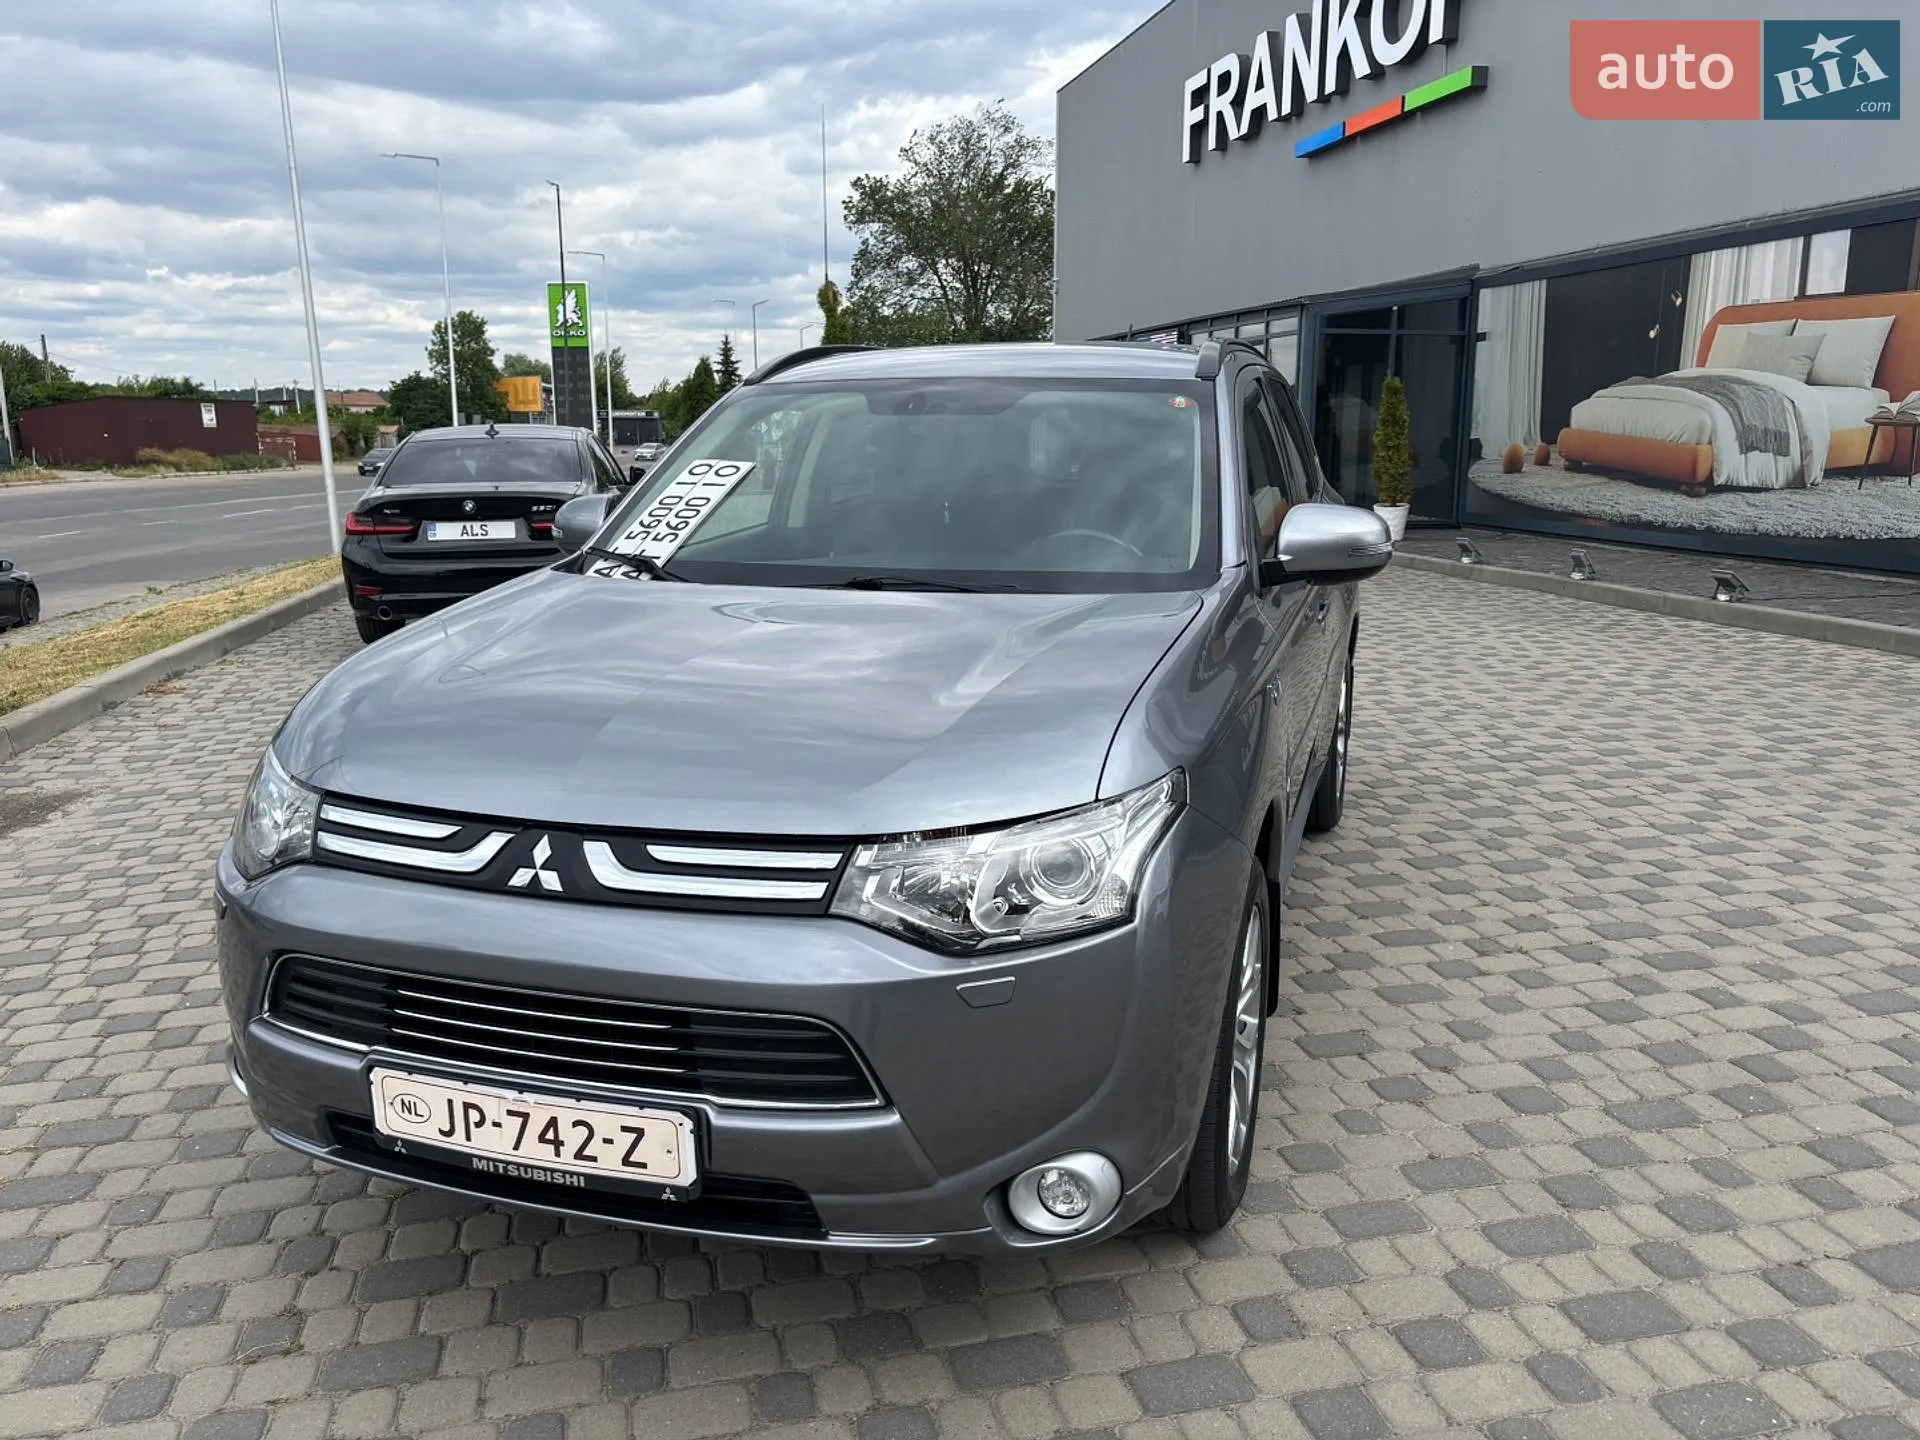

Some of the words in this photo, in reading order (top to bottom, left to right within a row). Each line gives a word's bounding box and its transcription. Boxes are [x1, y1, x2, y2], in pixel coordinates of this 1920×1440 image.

[460, 524, 489, 537] ALS
[625, 495, 684, 541] 5600
[652, 496, 711, 543] 5600
[400, 1099, 425, 1119] NL
[438, 1098, 648, 1170] JP-742-Z
[472, 1157, 585, 1188] MITSUBISHI
